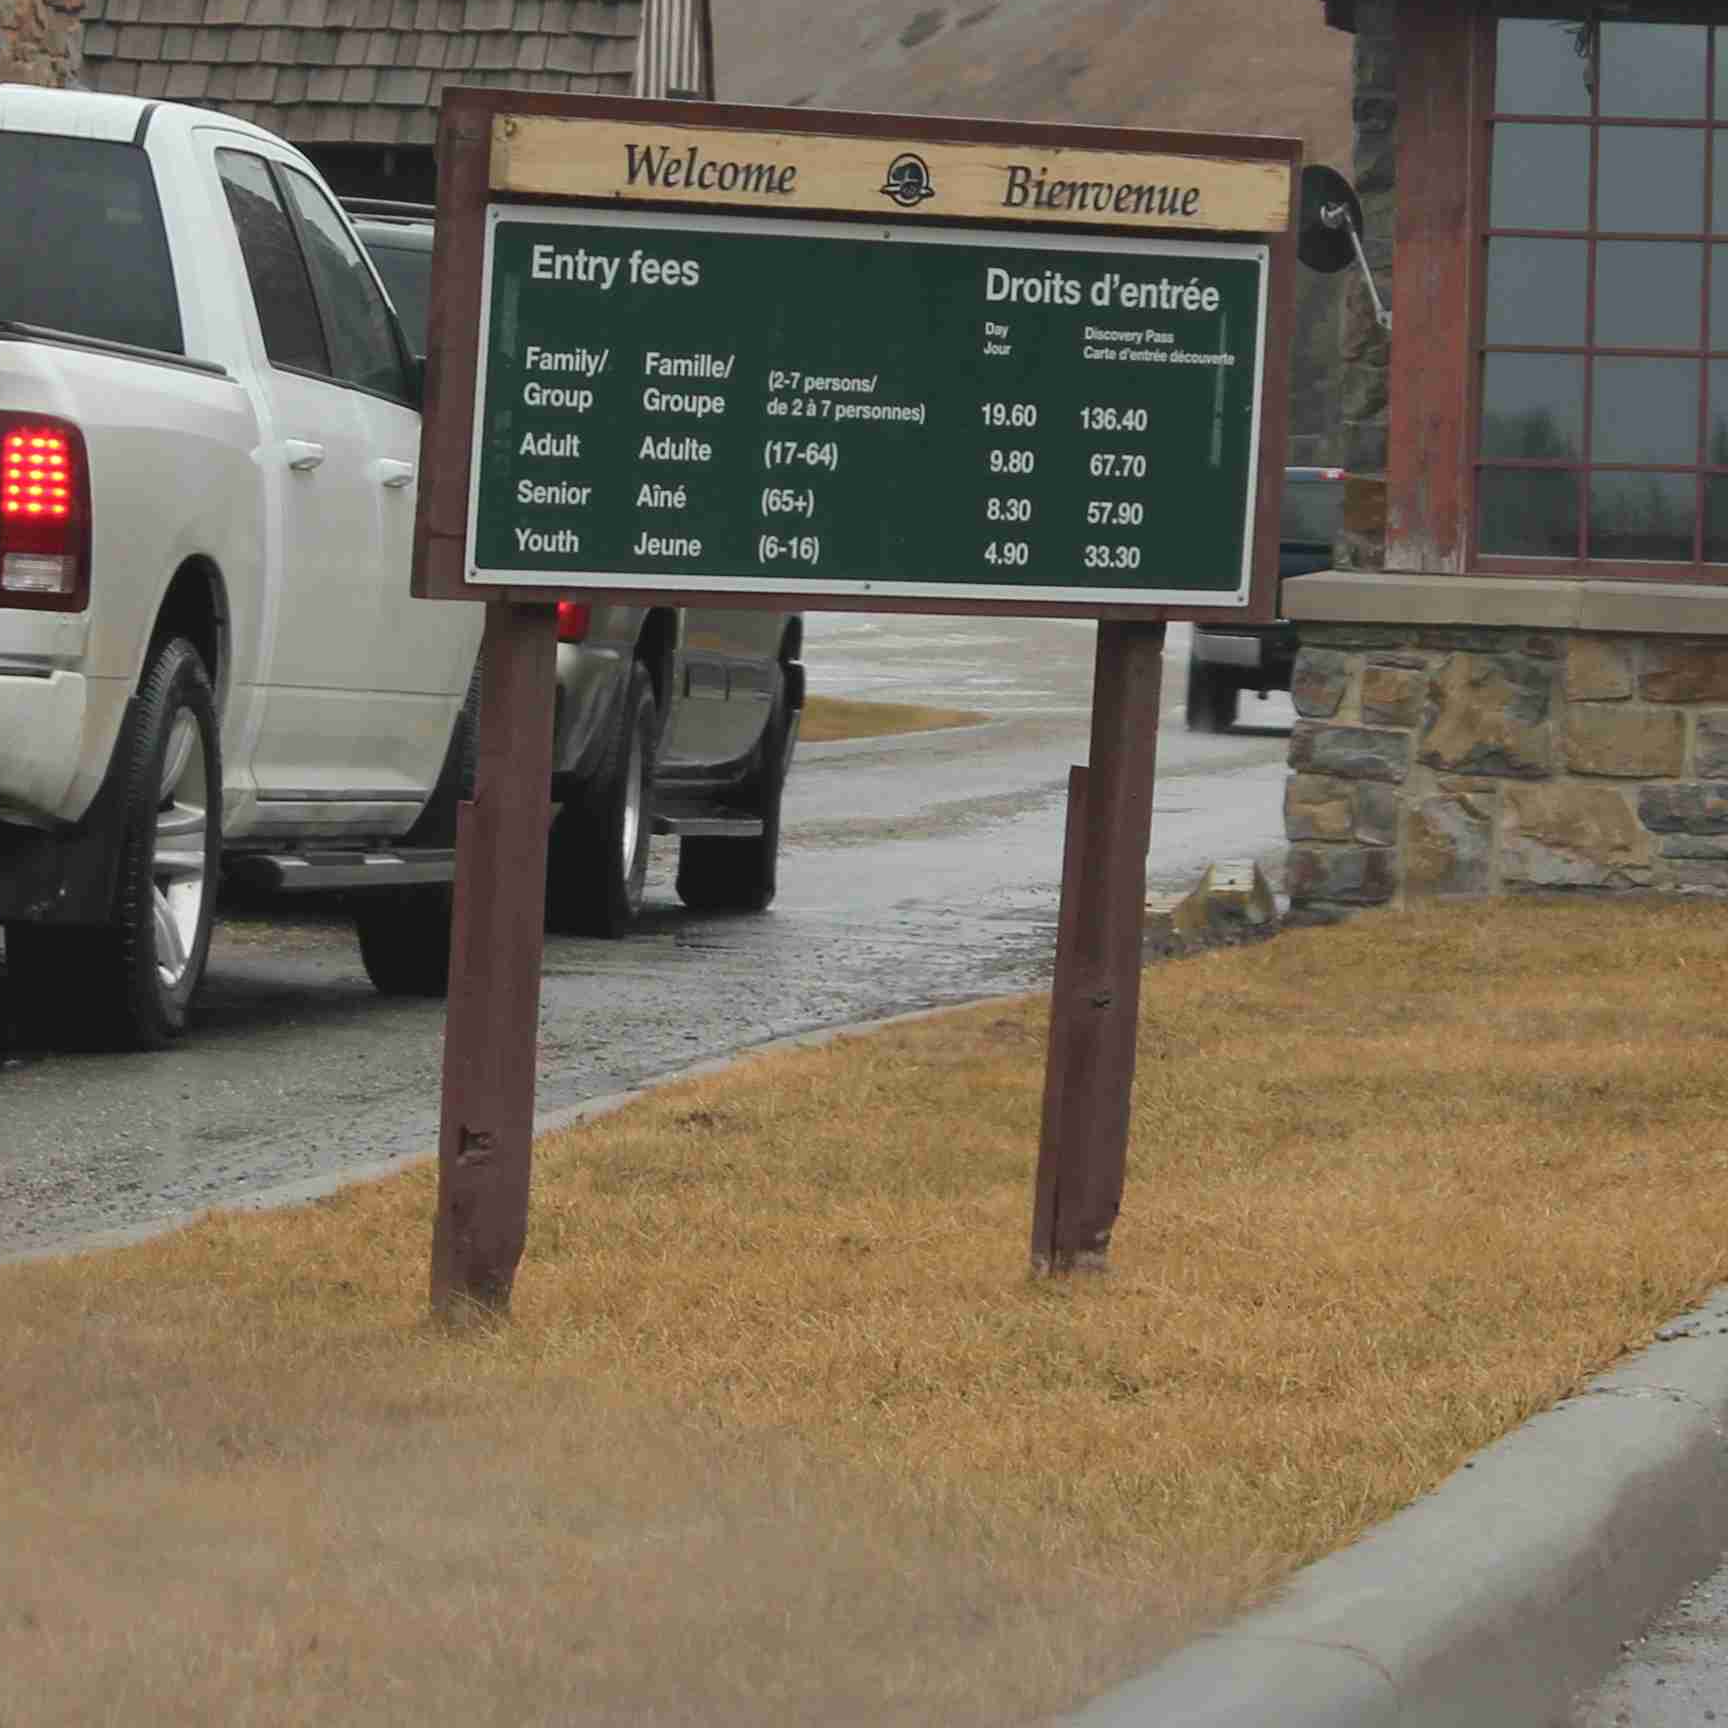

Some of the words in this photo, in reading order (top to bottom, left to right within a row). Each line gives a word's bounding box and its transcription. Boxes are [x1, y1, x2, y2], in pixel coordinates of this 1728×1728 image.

[624, 143, 797, 194] Welcome
[1002, 164, 1201, 215] Bienvenue
[531, 244, 620, 290] Entry
[628, 250, 700, 286] fees
[985, 267, 1082, 306] Droits
[1090, 273, 1221, 311] d'entrée
[985, 322, 1009, 339] Day
[1084, 326, 1143, 344] Discovery
[1145, 329, 1174, 344] Pass
[525, 346, 609, 377] Family/
[983, 342, 1011, 356] Jour
[1083, 346, 1117, 361] Carte
[1119, 347, 1168, 363] d'entrée
[1170, 349, 1236, 366] découverte
[644, 351, 735, 379] Famille/
[768, 371, 801, 392] (2-7
[803, 374, 878, 395] persons/
[523, 382, 594, 413] Group
[642, 387, 726, 418] Groupe
[766, 398, 788, 416] de
[791, 399, 804, 416] 2
[805, 398, 817, 417] à
[820, 400, 832, 417] 7
[834, 403, 926, 424] personnes)
[981, 403, 1038, 426] 19.60
[1079, 407, 1148, 431] 136.40
[519, 432, 580, 458] Adult
[638, 436, 713, 462] Adulte
[763, 440, 839, 471] (17-64)
[989, 449, 1035, 473] 9.80
[1089, 453, 1147, 477] 67.70
[516, 478, 592, 505] Senior
[636, 482, 687, 509] Aîné
[760, 488, 815, 518] (65+)
[986, 497, 1032, 521] 8.30
[1086, 501, 1144, 525] 57.90
[514, 527, 579, 553] Youth
[633, 531, 702, 558] Jeune
[758, 534, 821, 565] (6-16)
[984, 541, 1029, 565] 4.90
[1084, 545, 1141, 568] 33.30
